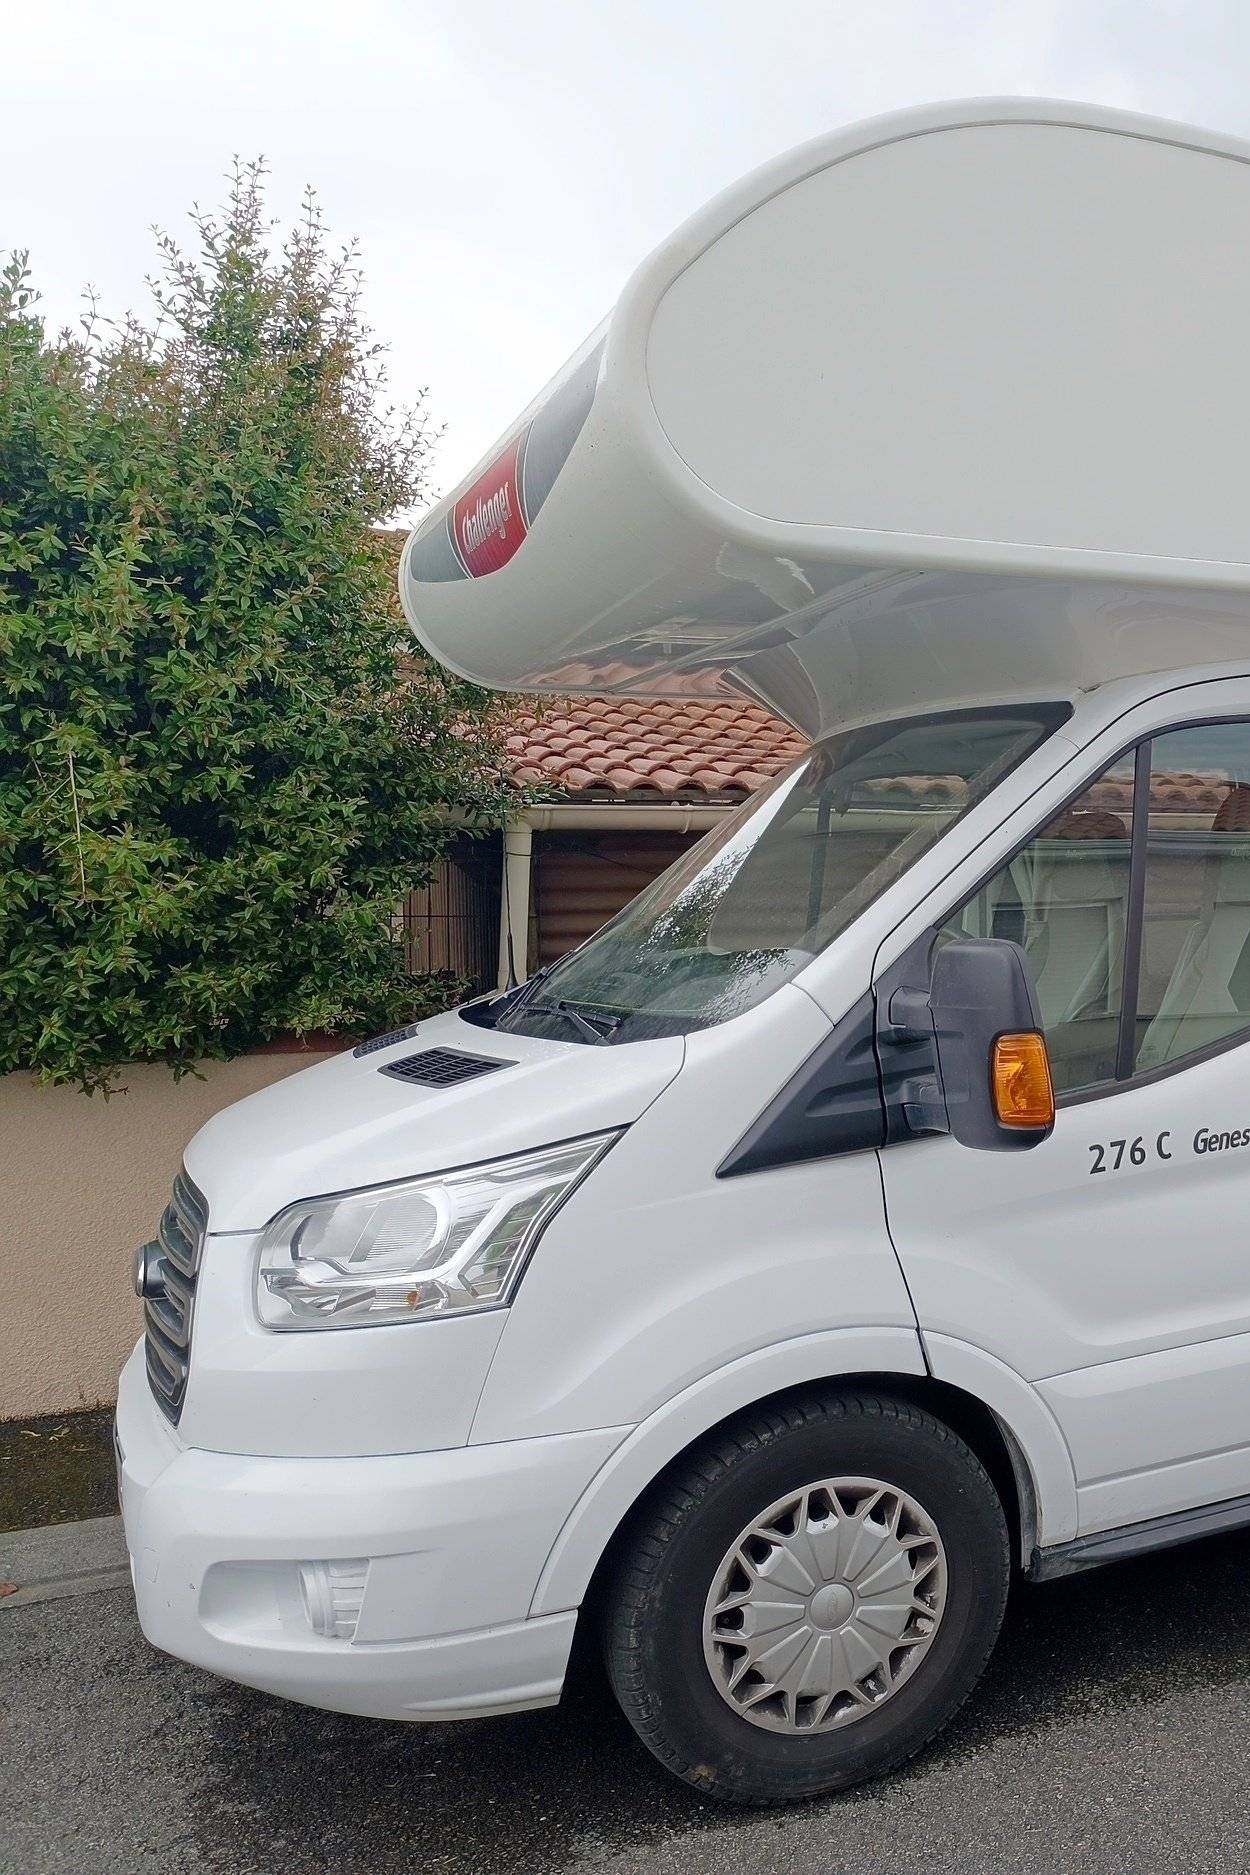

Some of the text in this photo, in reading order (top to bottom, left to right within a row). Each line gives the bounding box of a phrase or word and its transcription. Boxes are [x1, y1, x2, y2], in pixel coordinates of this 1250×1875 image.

[462, 482, 512, 554] Challenger
[1089, 1136, 1146, 1174] 276
[1156, 1131, 1172, 1160] C
